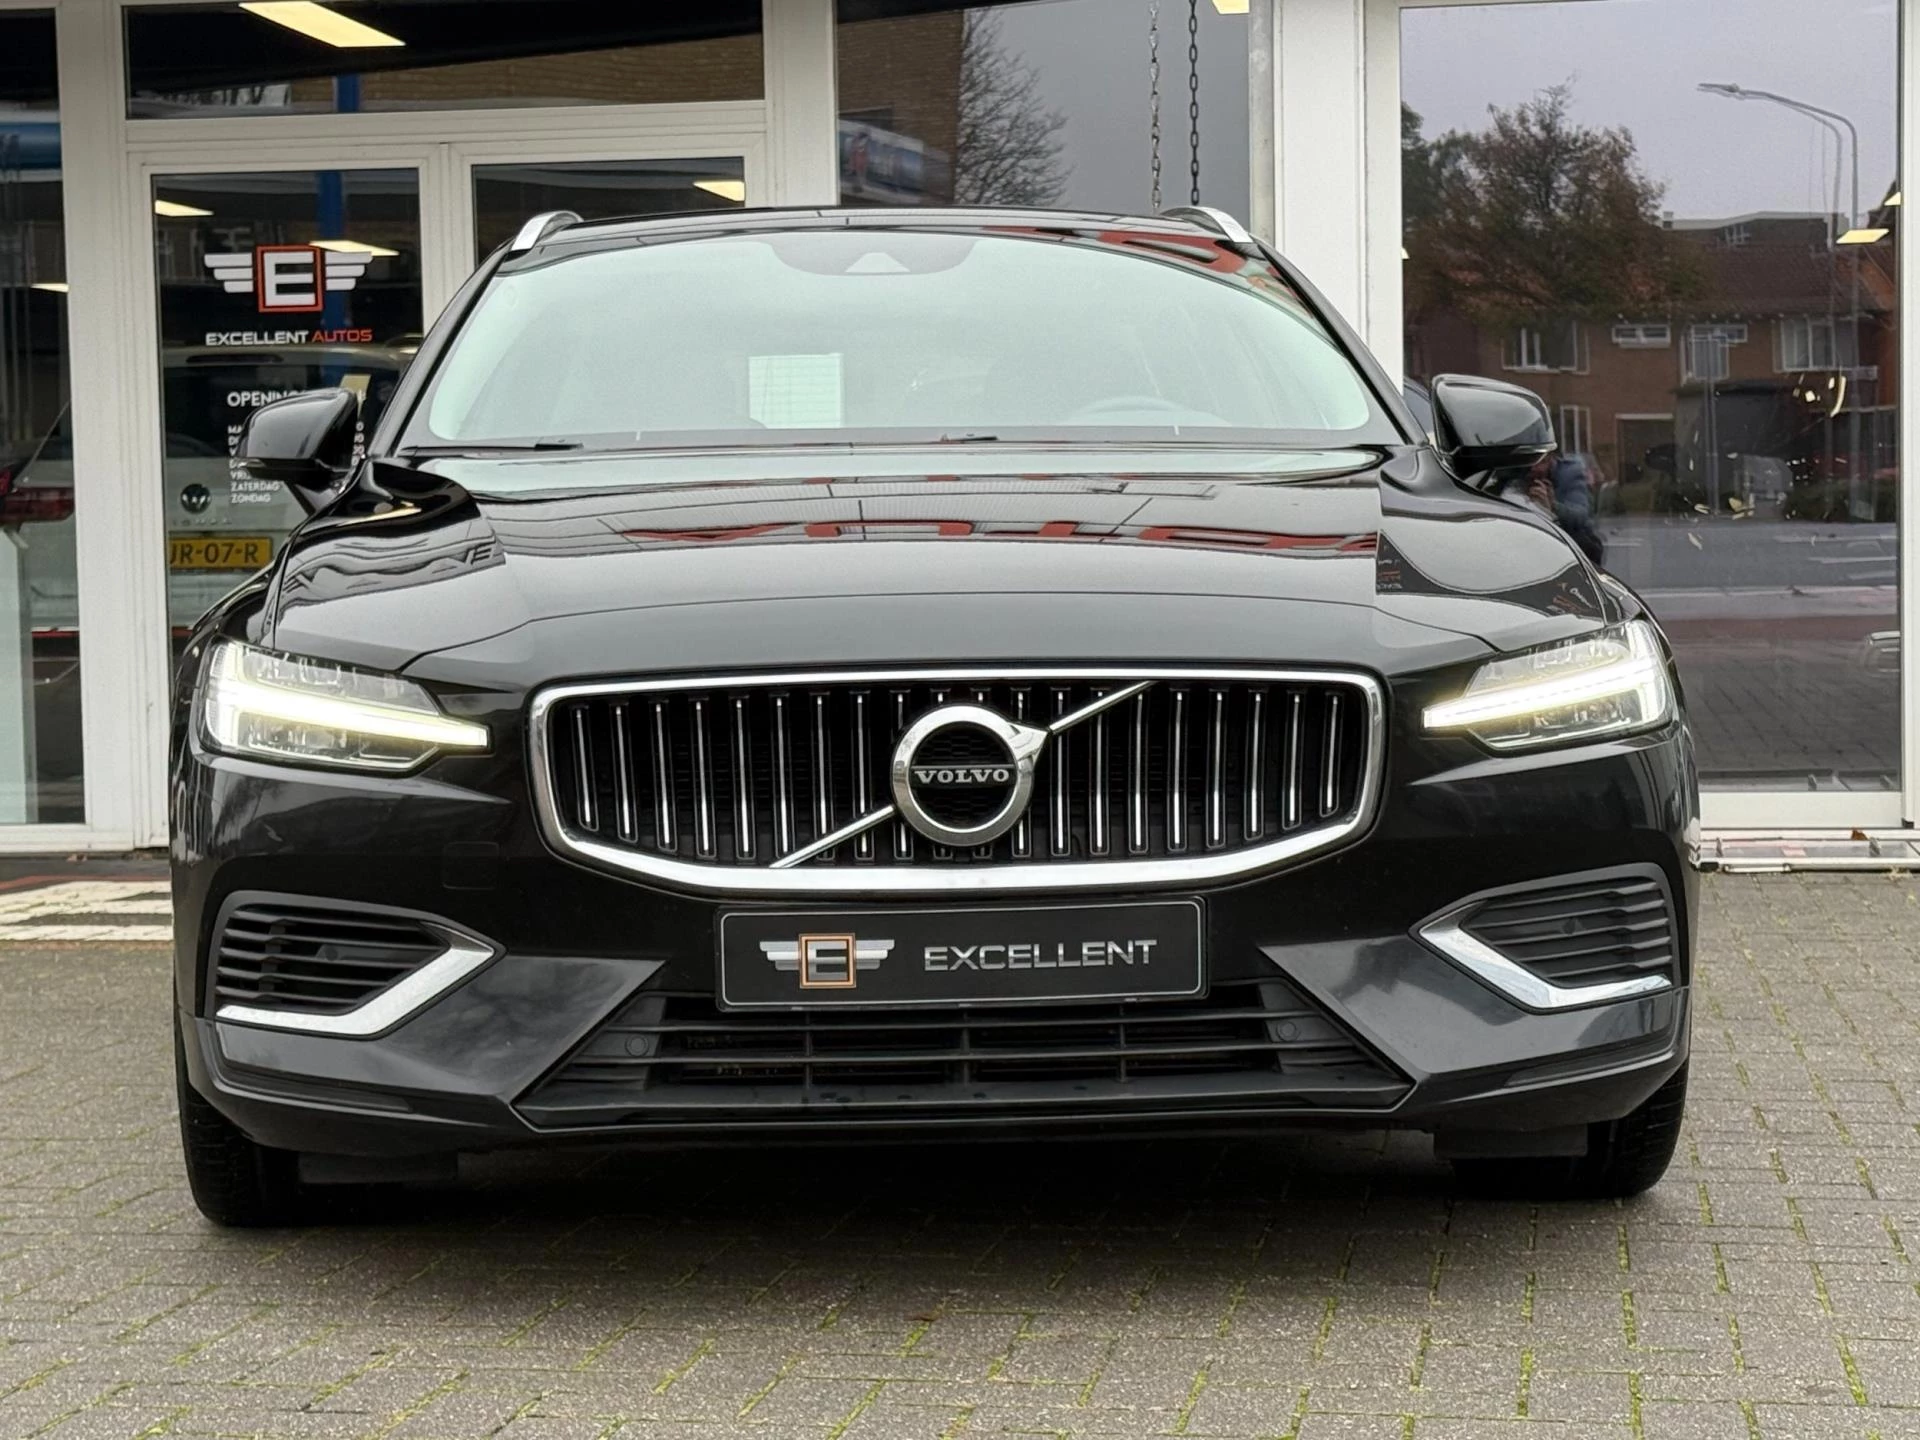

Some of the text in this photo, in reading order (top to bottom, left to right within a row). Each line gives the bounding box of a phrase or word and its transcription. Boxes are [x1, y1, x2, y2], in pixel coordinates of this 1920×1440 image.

[264, 251, 315, 306] E
[205, 329, 372, 345] EXCELLENT AUTOS
[914, 768, 1009, 784] VOLVO
[808, 941, 847, 980] E
[924, 940, 1157, 971] EXCELLENT
